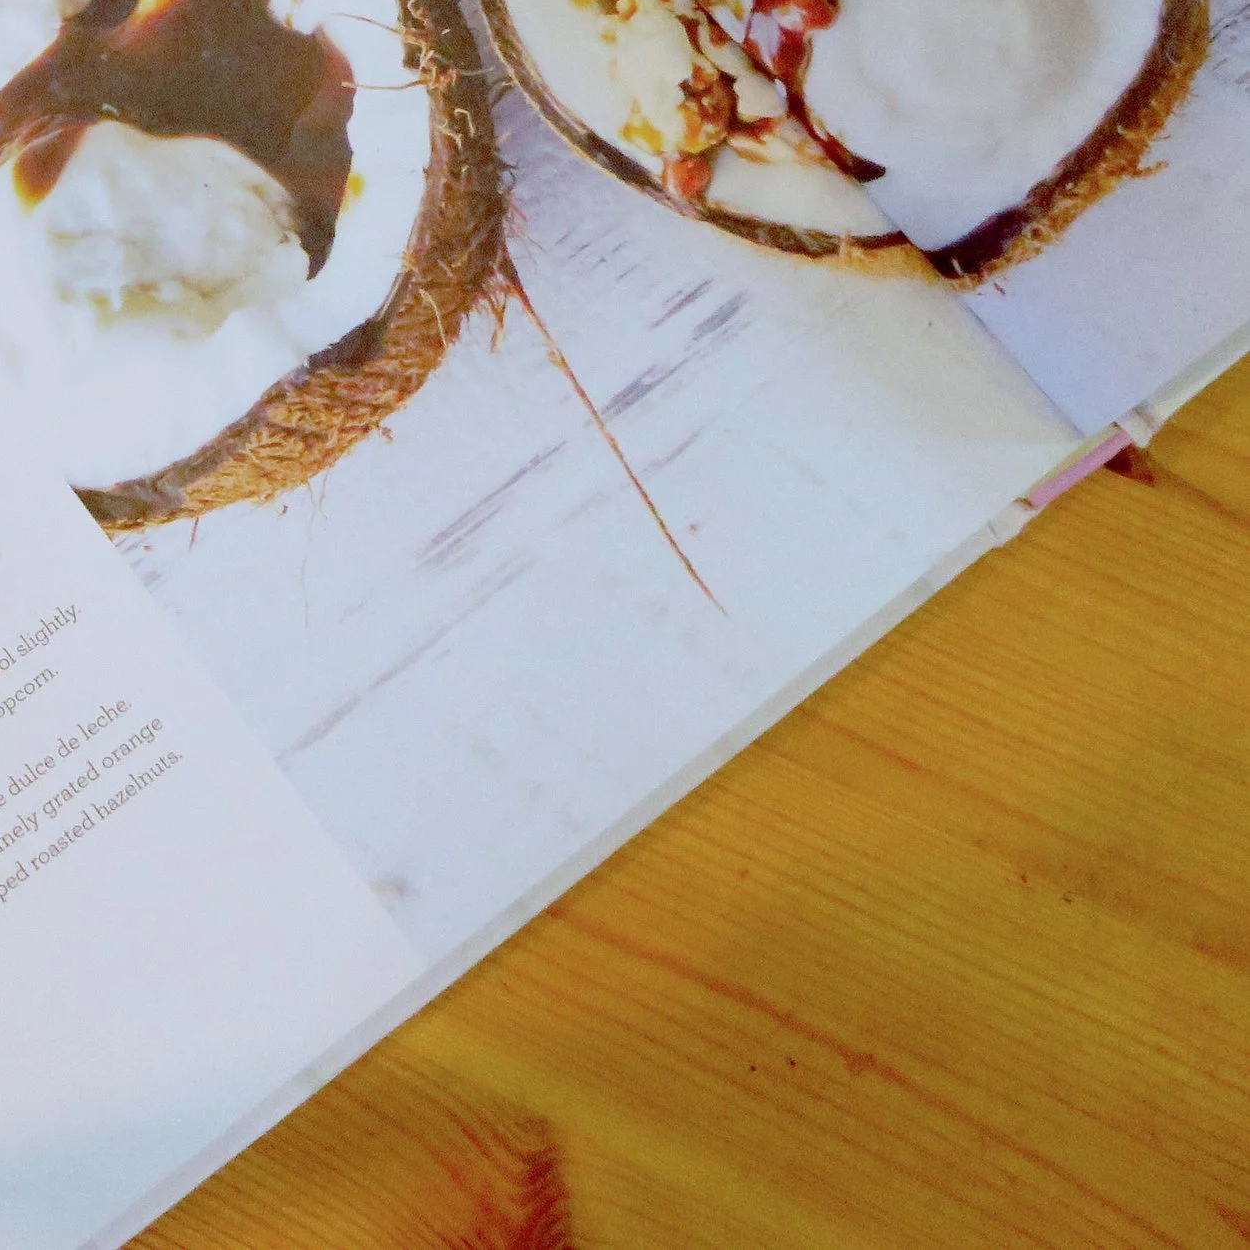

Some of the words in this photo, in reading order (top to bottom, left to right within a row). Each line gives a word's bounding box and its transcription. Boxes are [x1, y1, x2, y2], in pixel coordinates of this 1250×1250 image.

[8, 756, 54, 796] dulce
[57, 737, 80, 758] de
[77, 700, 132, 741] leche.
[42, 759, 101, 820] grated
[101, 717, 164, 769] orange
[30, 809, 96, 872] roasted
[89, 751, 184, 821] hazelnuts.
